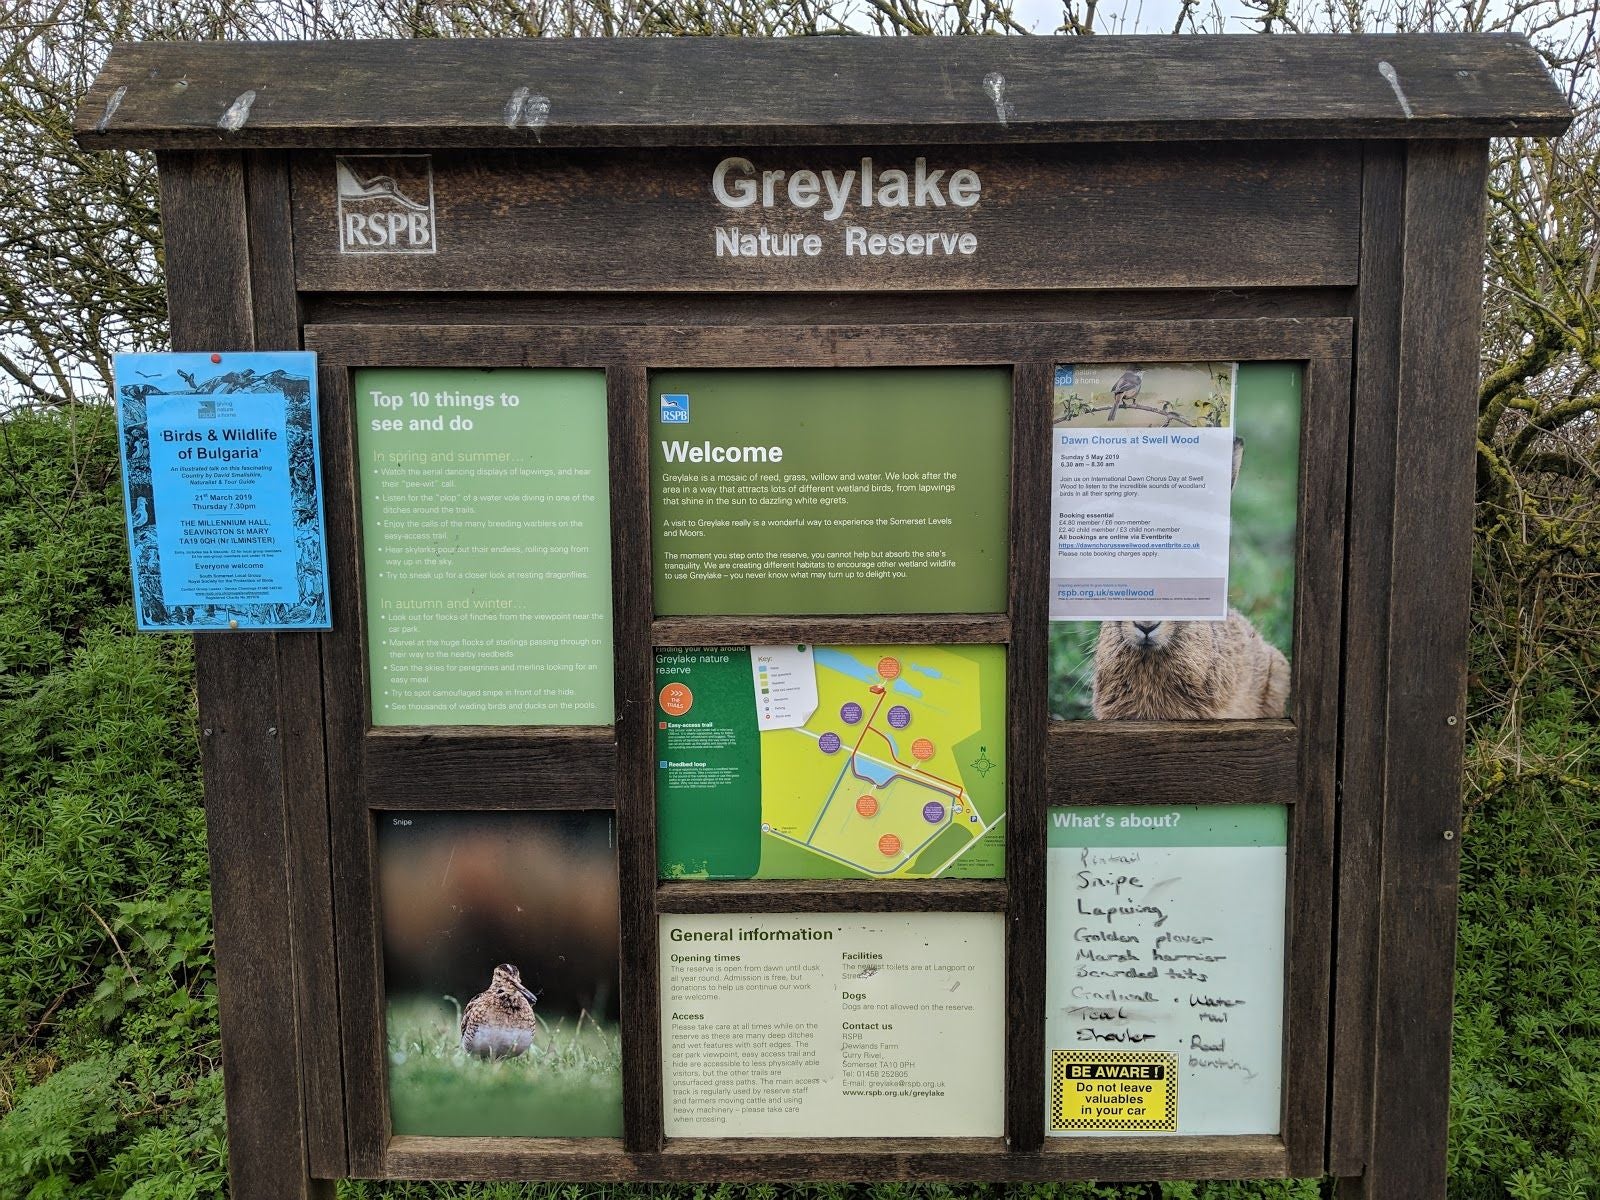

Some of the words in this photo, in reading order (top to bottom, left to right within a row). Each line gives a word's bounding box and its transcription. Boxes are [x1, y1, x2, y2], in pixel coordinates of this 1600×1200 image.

[713, 157, 982, 220] Greylake
[346, 214, 429, 245] RSPB
[715, 227, 821, 256] Nature
[845, 226, 977, 256] Reserve
[1055, 376, 1071, 385] spb
[370, 392, 403, 410] Top
[410, 392, 429, 406] 10
[435, 392, 494, 410] things
[500, 393, 519, 406] to
[663, 411, 688, 421] RSPB
[372, 418, 402, 431] see
[409, 415, 443, 431] and
[450, 415, 473, 431] do
[208, 430, 218, 441] &
[223, 429, 277, 440] Wildlife
[1062, 436, 1088, 444] Dawn
[1092, 436, 1127, 444] Chorus
[1142, 435, 1168, 444] Swell
[1171, 435, 1199, 443] Wood
[178, 448, 192, 459] of
[374, 451, 383, 462] In
[389, 451, 426, 464] spring
[431, 451, 454, 461] and
[662, 441, 783, 463] Welcome
[662, 474, 698, 482] Greylake
[811, 473, 837, 481] willow
[1058, 589, 1154, 597] rspb.org.uk/swellwood
[381, 599, 391, 609] In
[396, 600, 442, 609] autumn
[447, 599, 469, 608] and
[656, 655, 696, 665] Greylake
[700, 655, 729, 663] nature
[392, 689, 403, 698] Try
[416, 689, 431, 698] spot
[433, 688, 480, 698] camouflaged
[482, 688, 503, 697] snipe
[514, 688, 531, 696] front
[1121, 813, 1180, 827] about?
[1077, 871, 1143, 894] Snipe
[1078, 899, 1167, 926] Lapwing
[671, 928, 732, 941] General
[739, 928, 833, 941] information
[671, 954, 711, 963] Opening
[843, 952, 882, 960] Facilities
[843, 992, 866, 1001] Dogs
[1072, 1066, 1091, 1078] BE
[1095, 1066, 1149, 1078] AWARE
[1077, 1083, 1092, 1092] Do
[1098, 1083, 1116, 1092] not
[1121, 1083, 1152, 1092] leave
[1085, 1094, 1143, 1103] valuables
[1082, 1105, 1091, 1114] in
[1097, 1107, 1123, 1117] your
[1128, 1107, 1146, 1115] car
